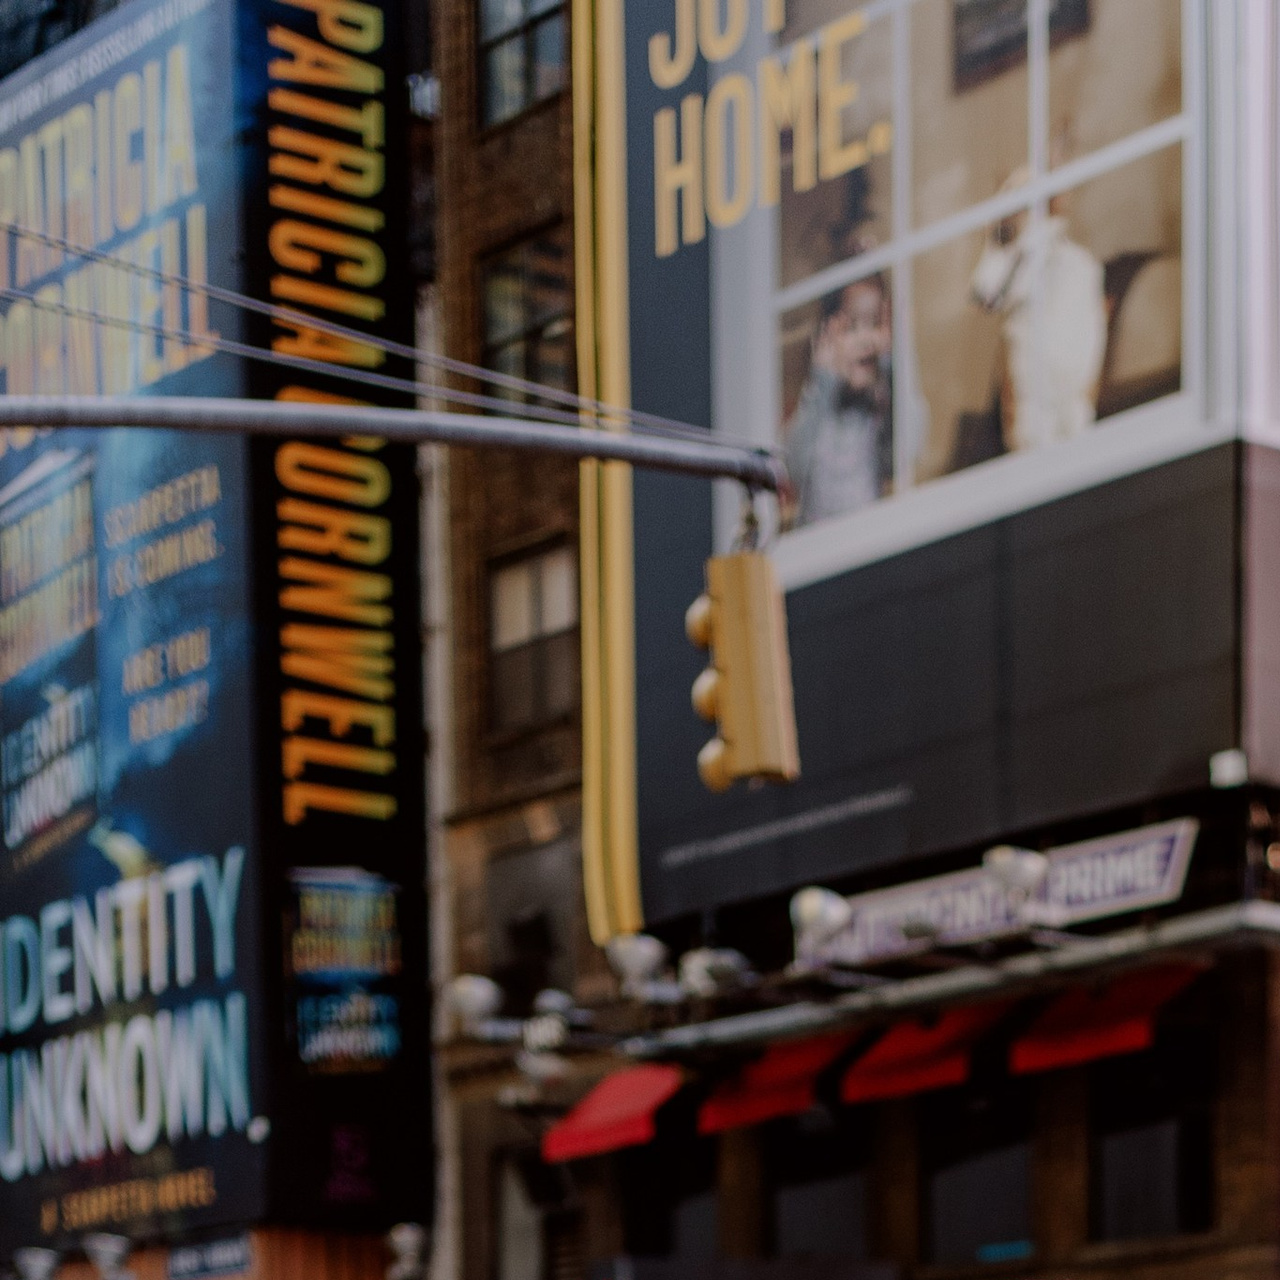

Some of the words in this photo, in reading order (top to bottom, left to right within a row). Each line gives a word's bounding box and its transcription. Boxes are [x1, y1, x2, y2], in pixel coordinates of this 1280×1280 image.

[267, 0, 387, 369] PATRICIA
[653, 10, 893, 259] HOME.
[0, 989, 272, 1183] UNKNOWN.
